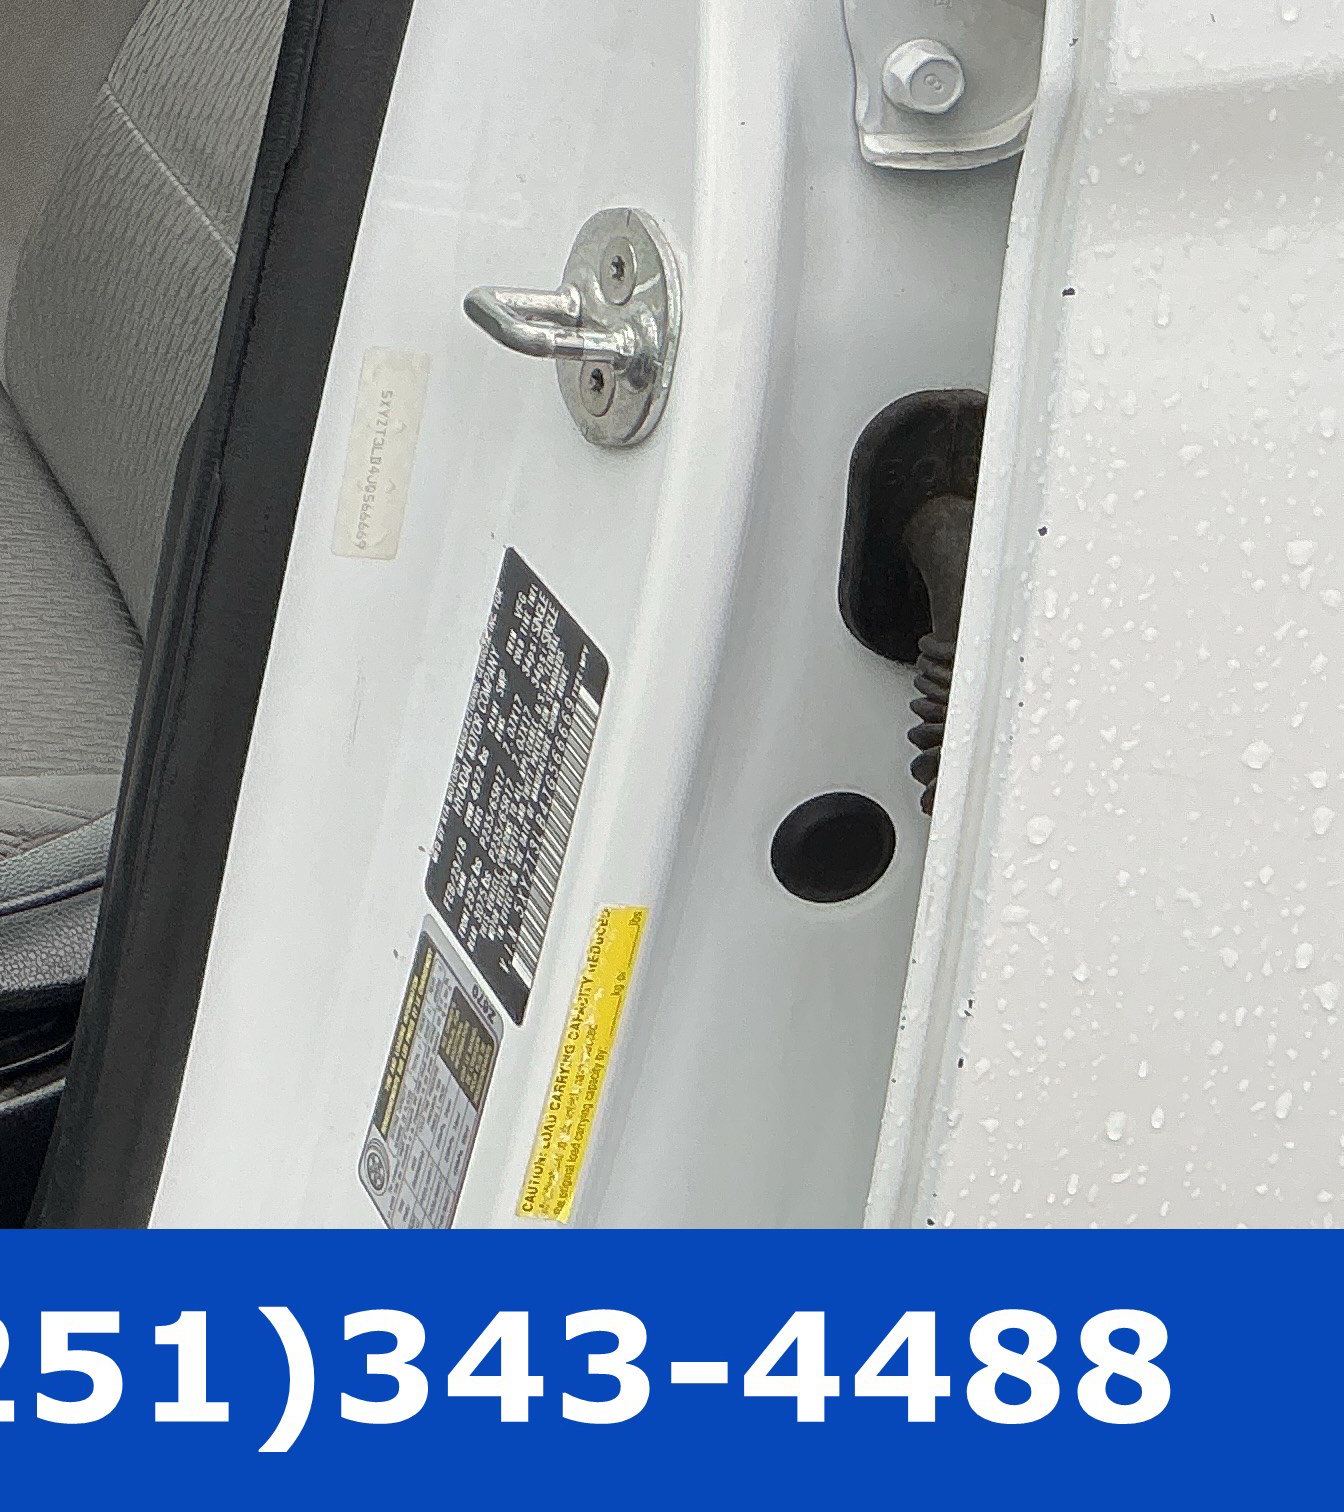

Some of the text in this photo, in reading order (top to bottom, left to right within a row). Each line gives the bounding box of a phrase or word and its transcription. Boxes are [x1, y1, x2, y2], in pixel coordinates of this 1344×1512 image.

[442, 833, 467, 913] FEB/23/18
[469, 762, 485, 805] 4872
[495, 665, 509, 700] SWP
[514, 589, 528, 623] VFG
[452, 643, 501, 817] HYUNDAI MOTOR COMPANY
[463, 871, 478, 912] 2976
[478, 763, 505, 852] P235/65R17
[531, 590, 549, 639] SINGLE
[472, 884, 487, 924] 3075
[487, 775, 515, 864] P235/65R17
[541, 601, 558, 650] SINGLE
